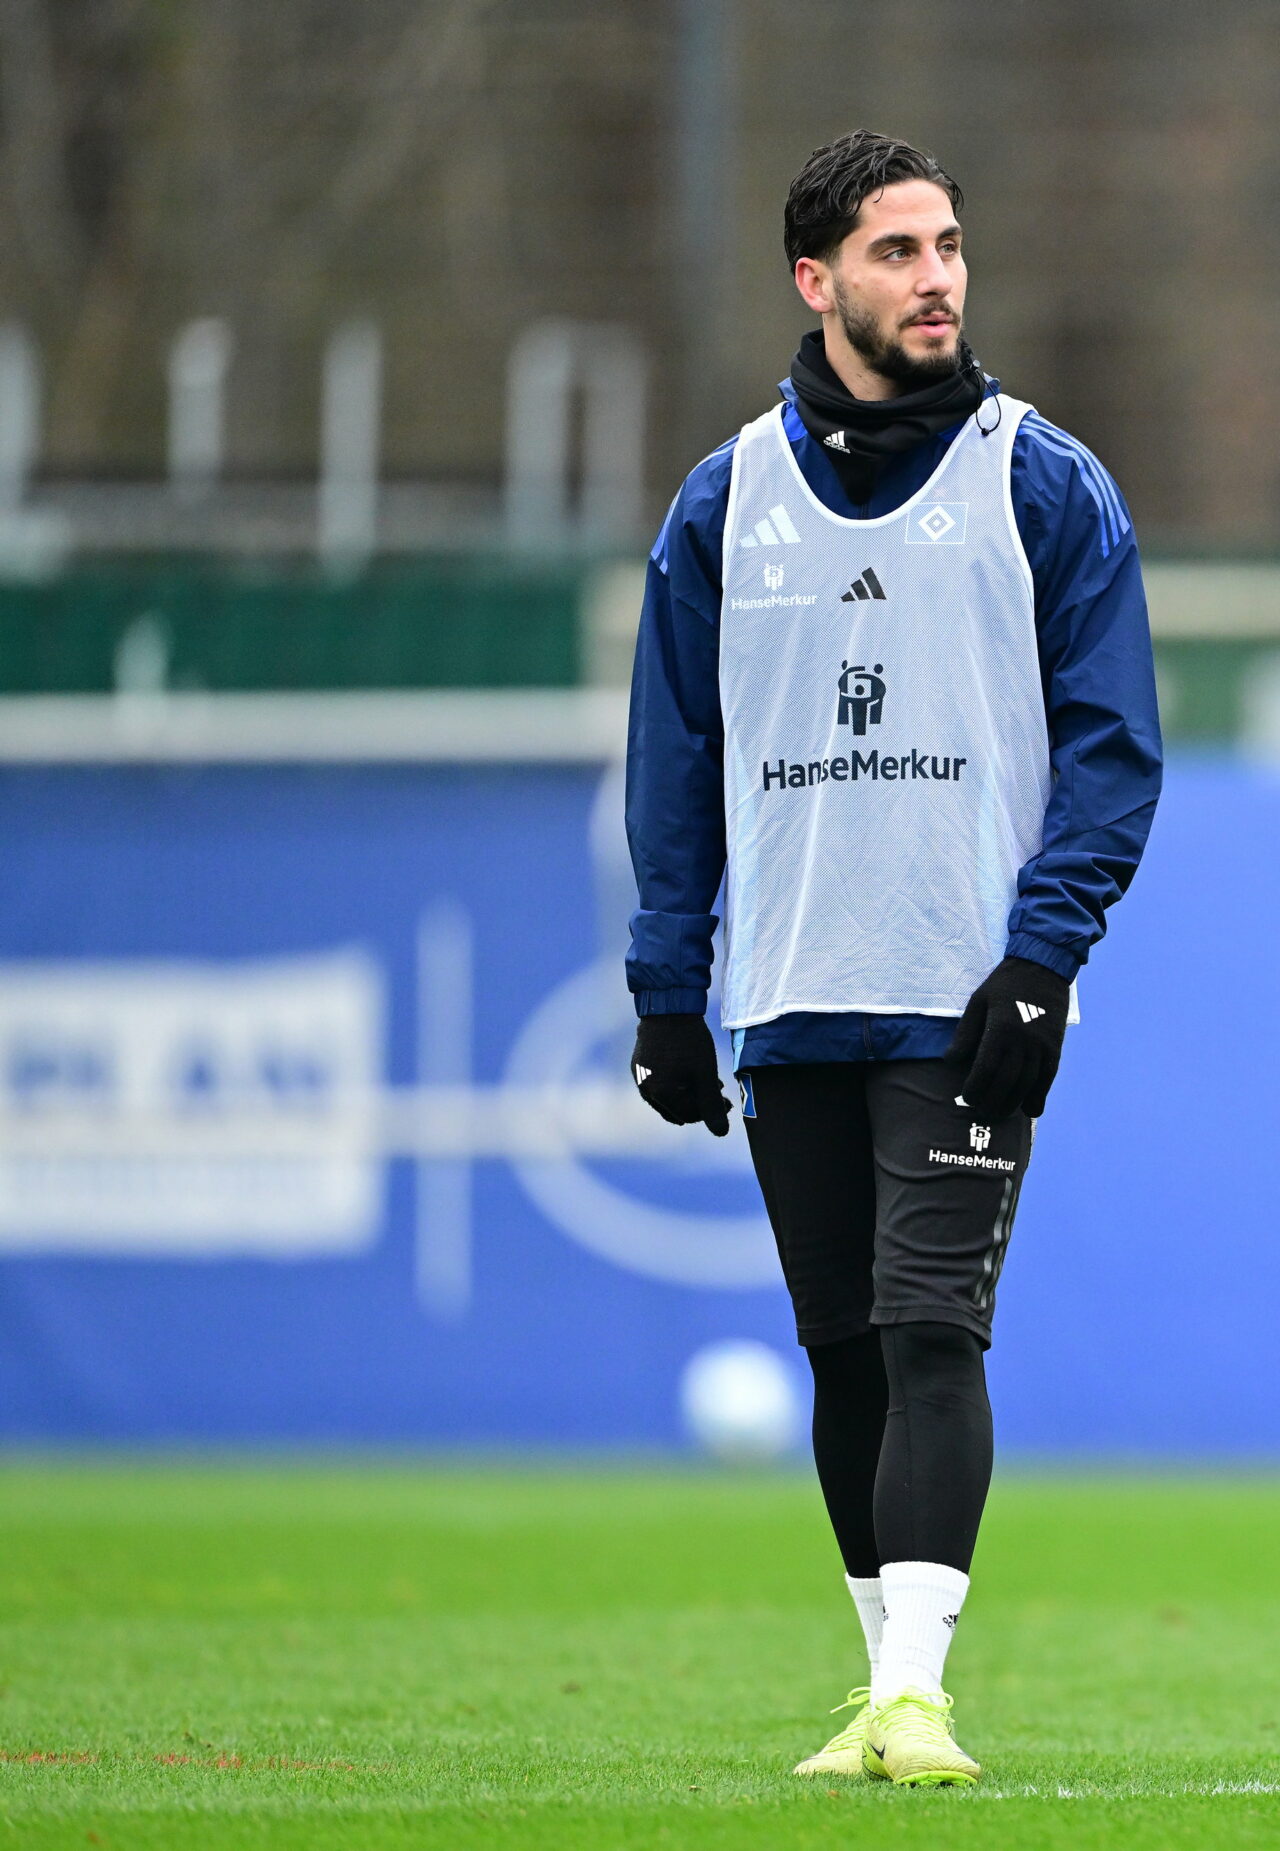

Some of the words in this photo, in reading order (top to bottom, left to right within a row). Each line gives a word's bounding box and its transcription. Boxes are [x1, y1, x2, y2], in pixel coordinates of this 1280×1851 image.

[731, 593, 818, 611] HanseMerkur
[762, 748, 967, 791] HanseMerkur
[928, 1149, 1016, 1170] HanseMerkur
